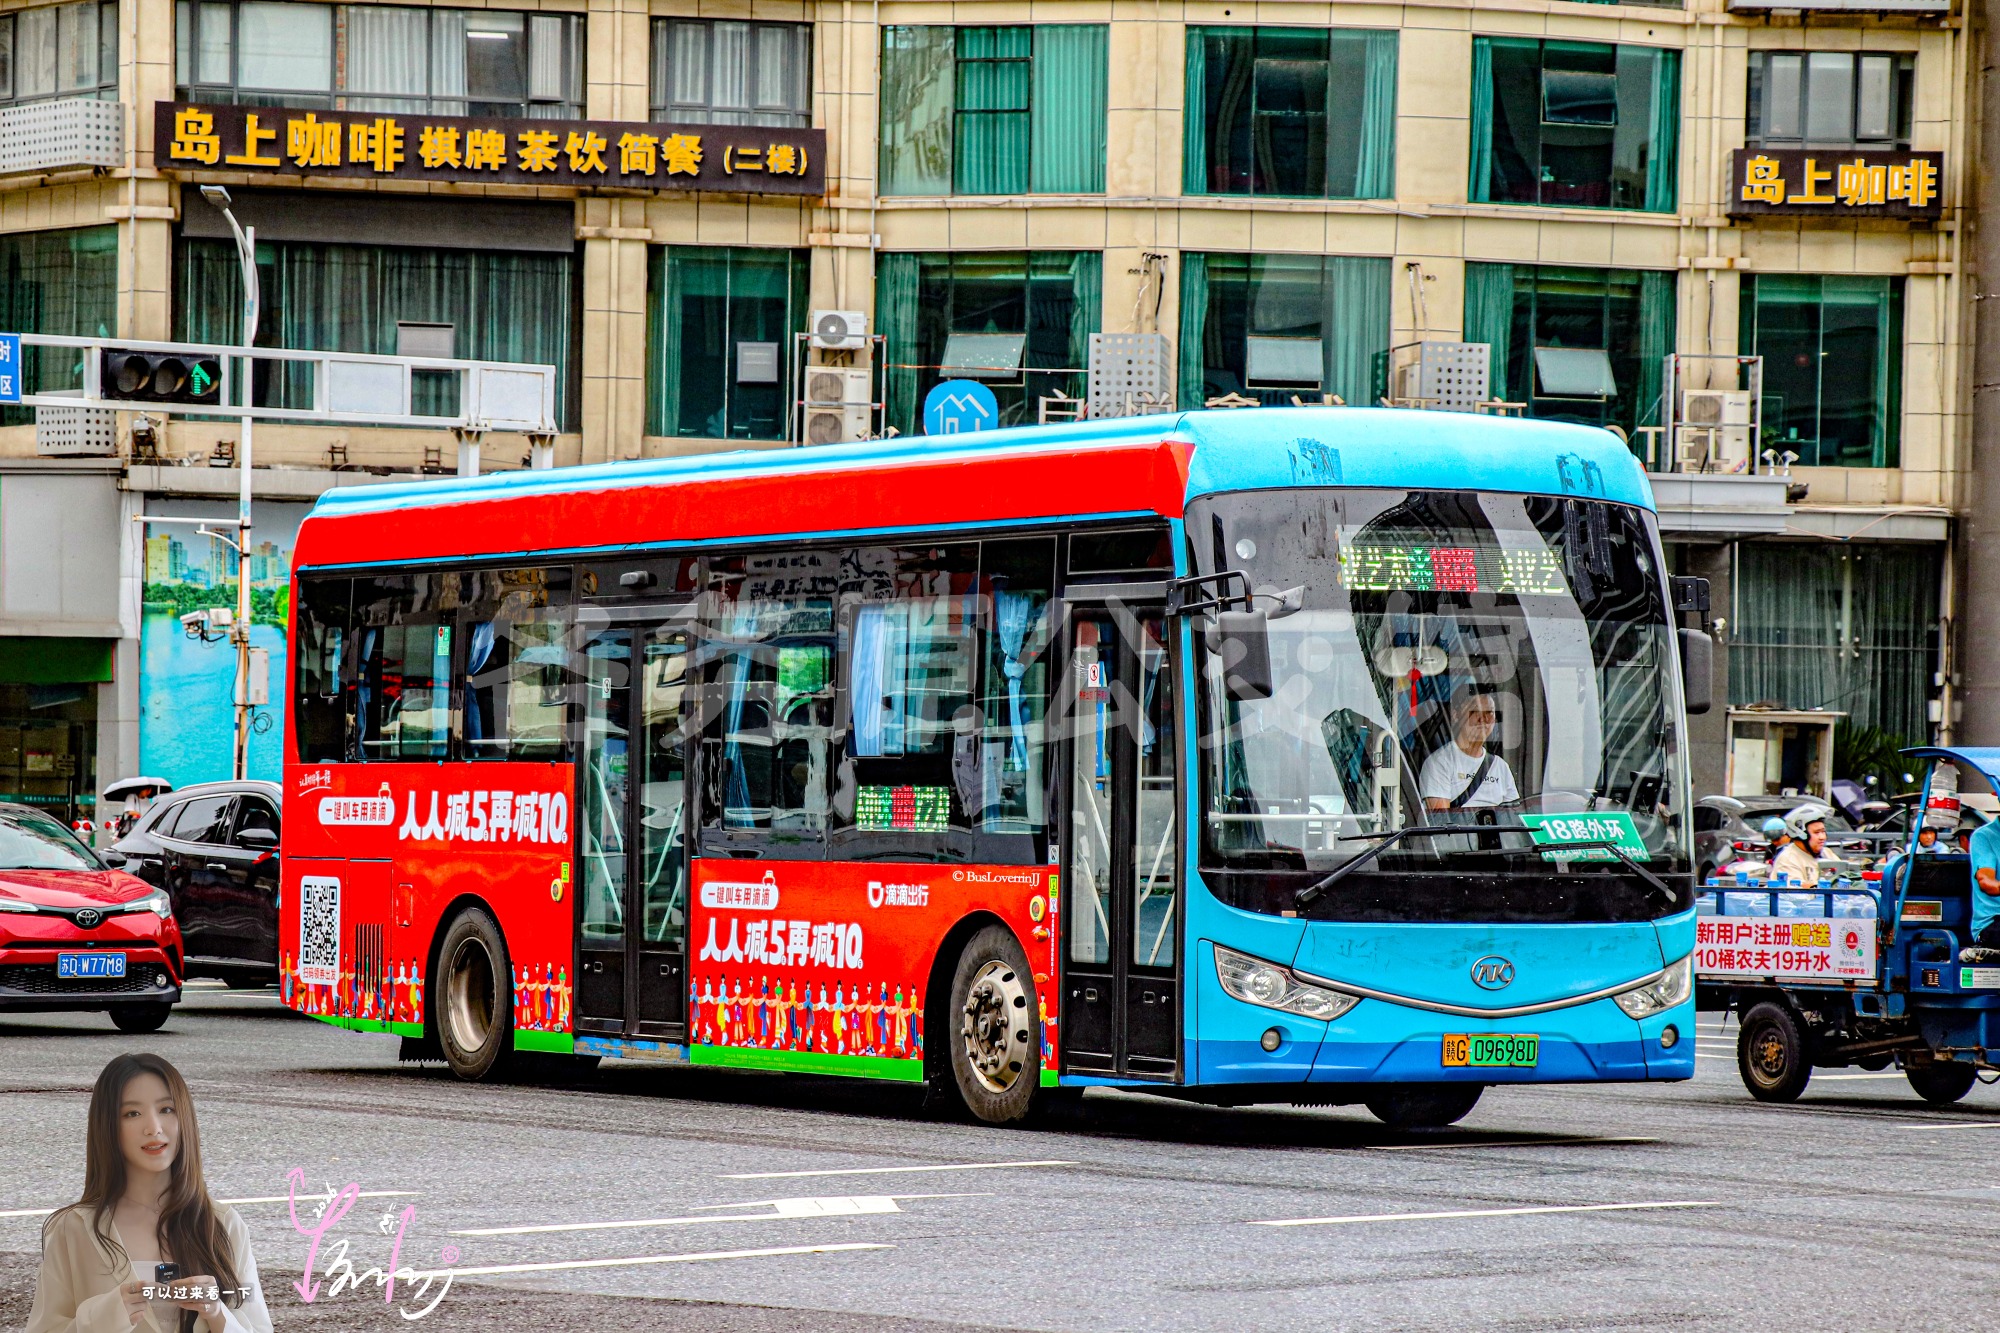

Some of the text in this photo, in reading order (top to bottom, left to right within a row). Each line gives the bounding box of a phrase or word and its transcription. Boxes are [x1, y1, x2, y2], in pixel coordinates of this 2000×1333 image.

[170, 108, 405, 172] 岛上咖啡
[1741, 155, 1938, 207] 岛上咖啡
[1603, 424, 1730, 464] TEL
[326, 801, 388, 821] 一键叫车用滴滴
[1539, 819, 1626, 840] 18路外环
[708, 886, 771, 906] 一键叫车用滴滴
[885, 884, 929, 906] 滴滴出行
[1697, 922, 1832, 948] 新用户注册赠送
[1695, 948, 1832, 972] 10桶农夫19升水
